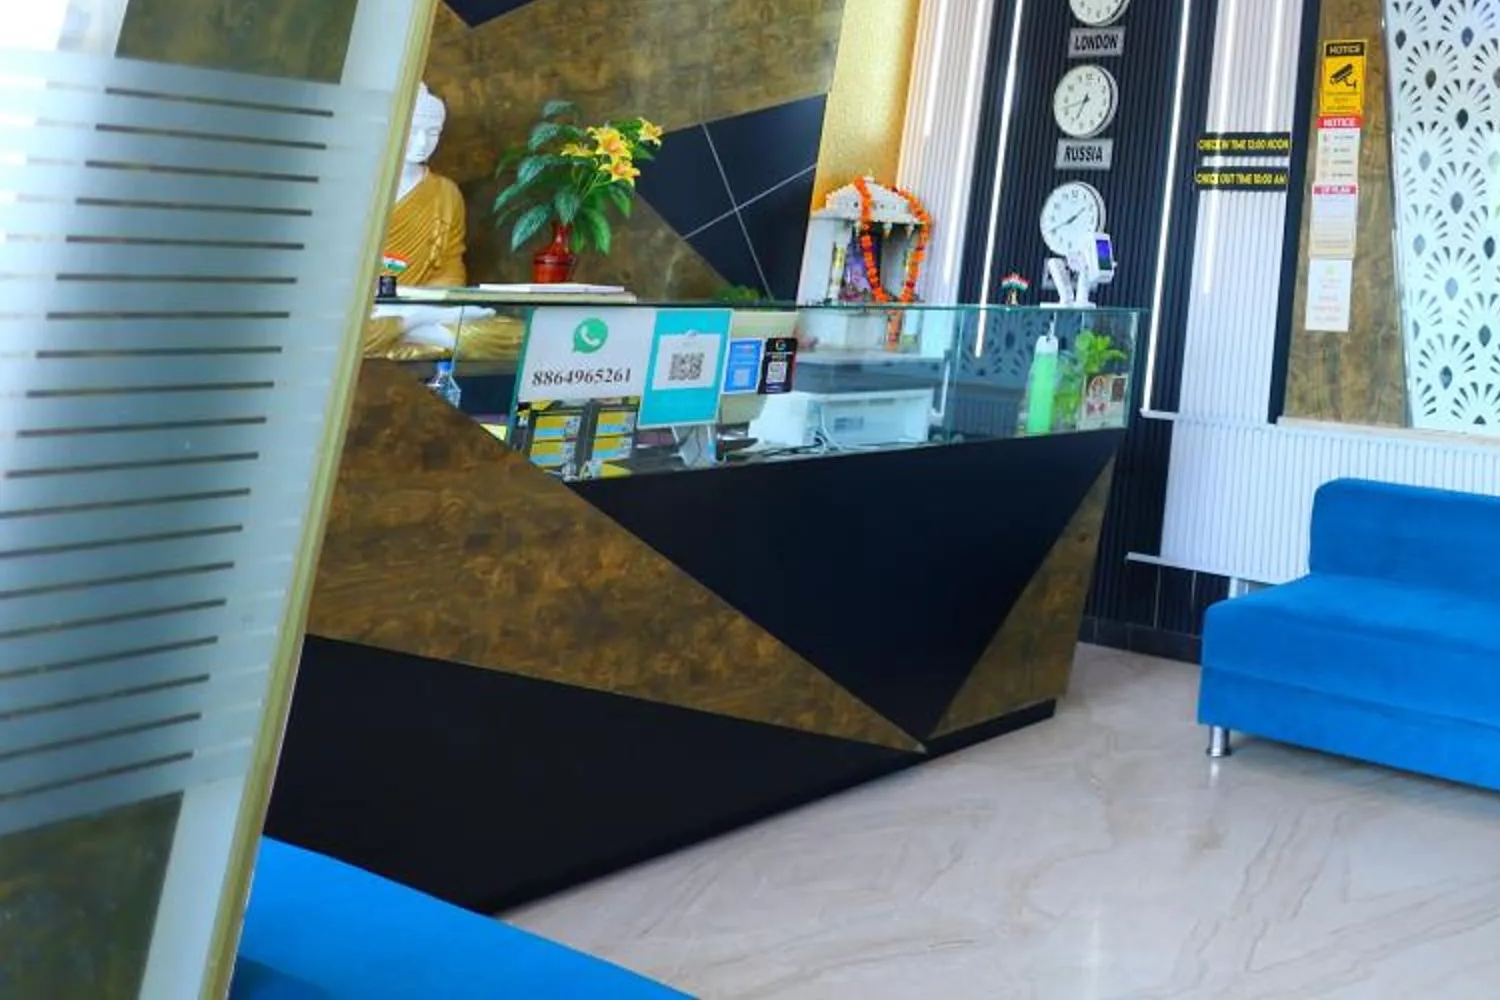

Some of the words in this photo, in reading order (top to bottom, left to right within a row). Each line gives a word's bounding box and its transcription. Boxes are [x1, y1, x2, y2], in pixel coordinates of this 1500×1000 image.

[1074, 33, 1119, 51] LONDON
[1329, 44, 1361, 55] NOTICE
[1323, 117, 1356, 128] NOTICE
[1064, 145, 1103, 163] RUSSIA
[531, 367, 631, 386] 8864965261
